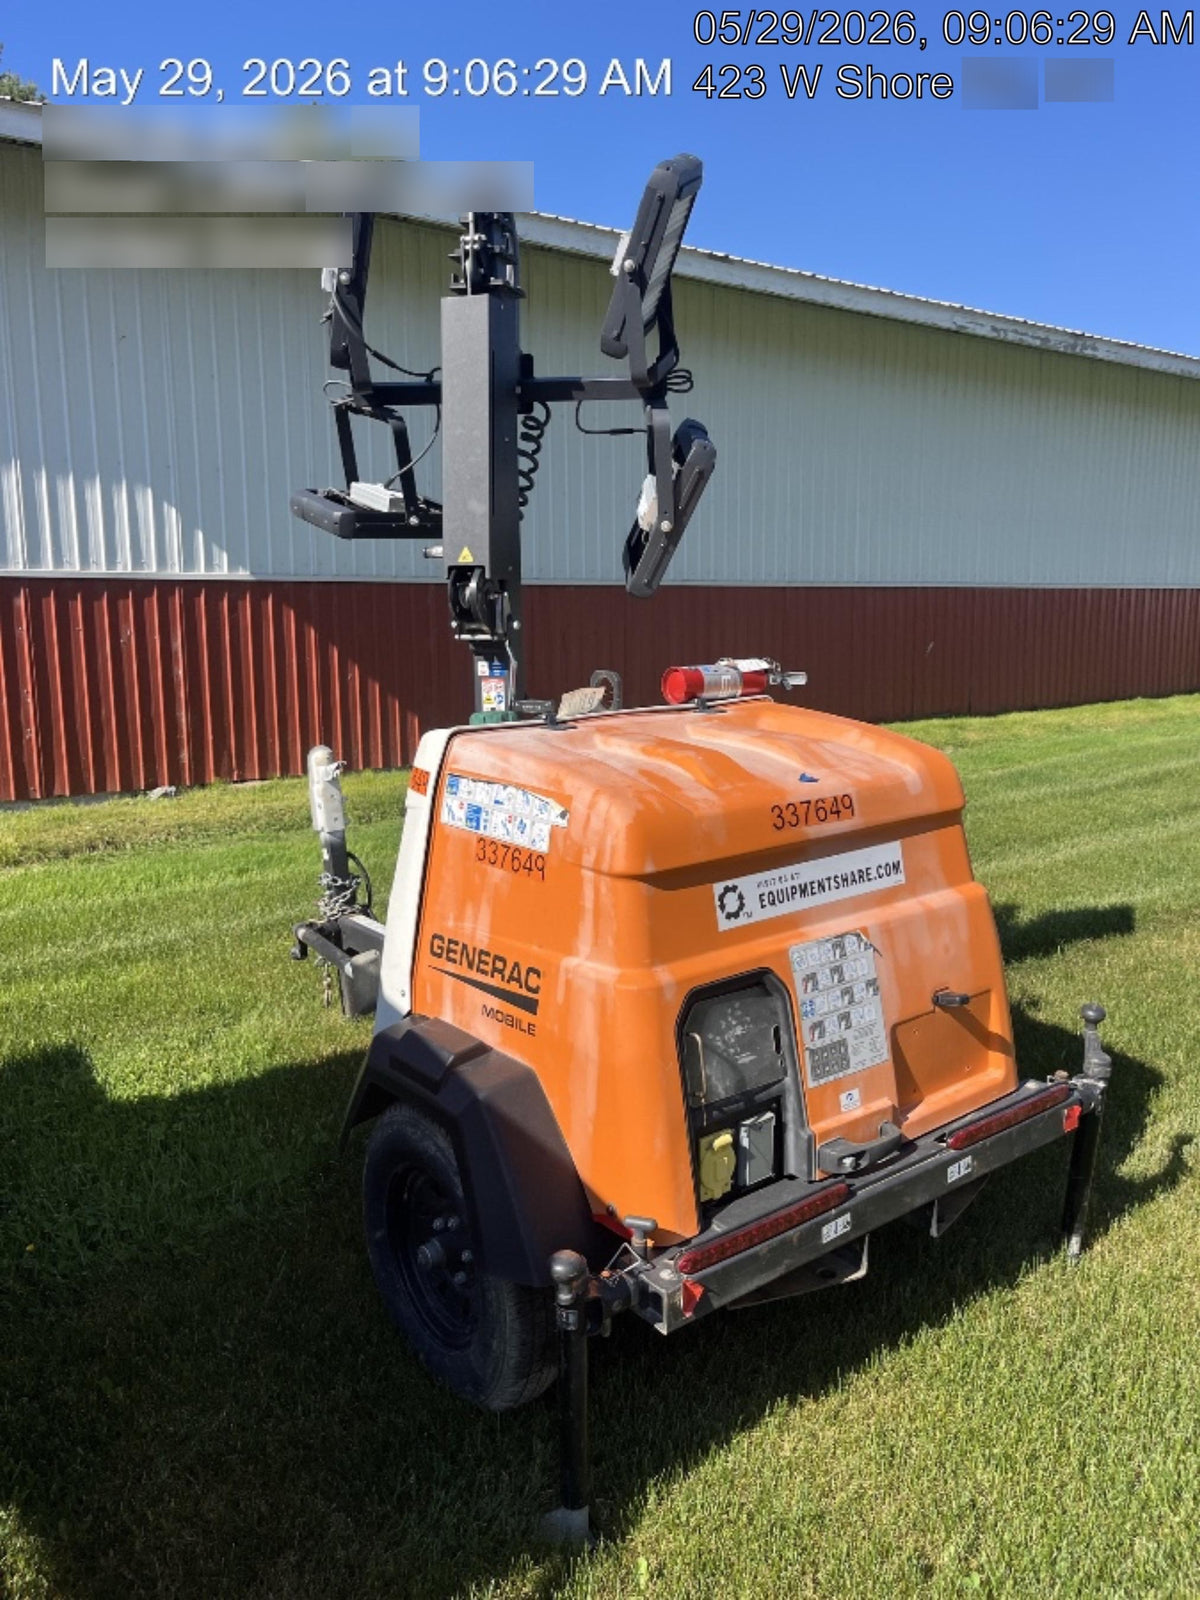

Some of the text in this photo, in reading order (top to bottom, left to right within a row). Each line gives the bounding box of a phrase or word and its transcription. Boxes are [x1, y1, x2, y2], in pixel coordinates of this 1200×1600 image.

[770, 793, 856, 832] 337649
[474, 836, 546, 882] 337649
[758, 859, 903, 910] EQUIPMENTSHARE.COM
[429, 932, 542, 995] GENERAC
[481, 1003, 537, 1037] MOBILE
